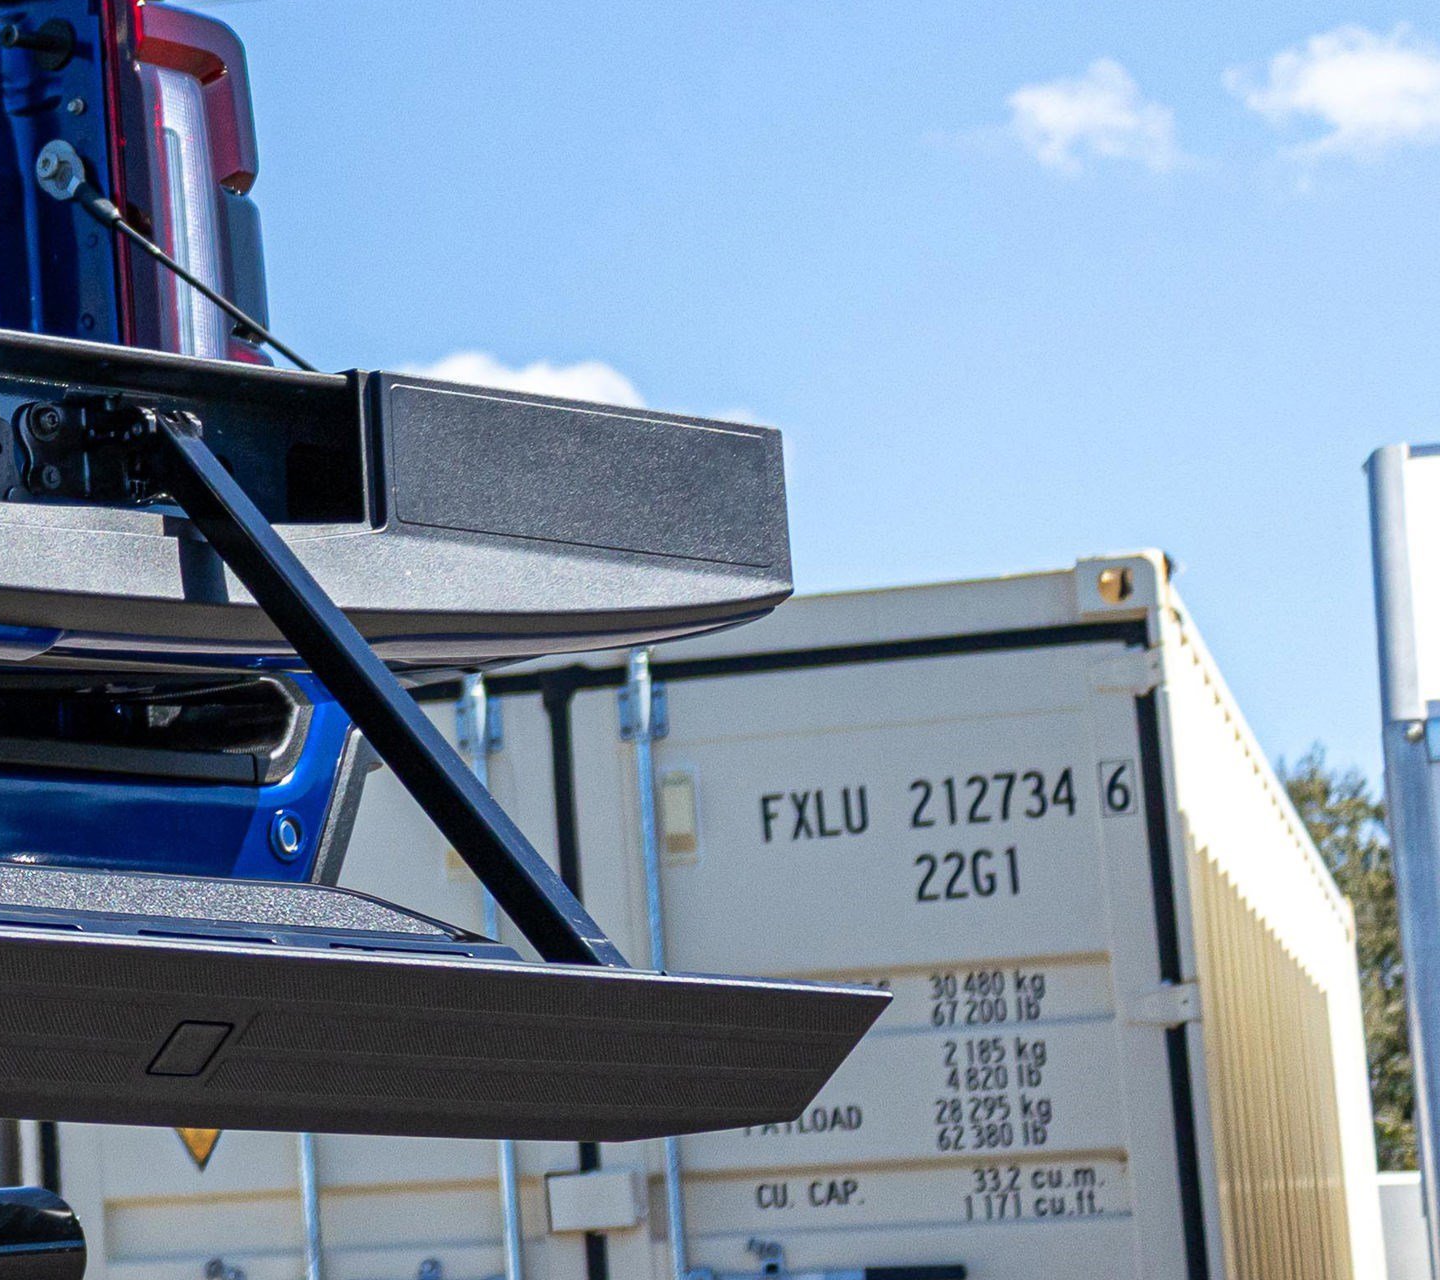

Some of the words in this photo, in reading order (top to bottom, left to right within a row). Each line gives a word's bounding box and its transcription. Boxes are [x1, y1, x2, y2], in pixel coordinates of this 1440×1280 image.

[760, 785, 870, 843] FXLU
[909, 766, 1076, 828] 212734
[1106, 764, 1131, 812] 6
[914, 846, 1021, 903] 22G1
[1015, 970, 1046, 1000] kg
[1015, 1037, 1047, 1068] kg
[1020, 1094, 1053, 1126] kg
